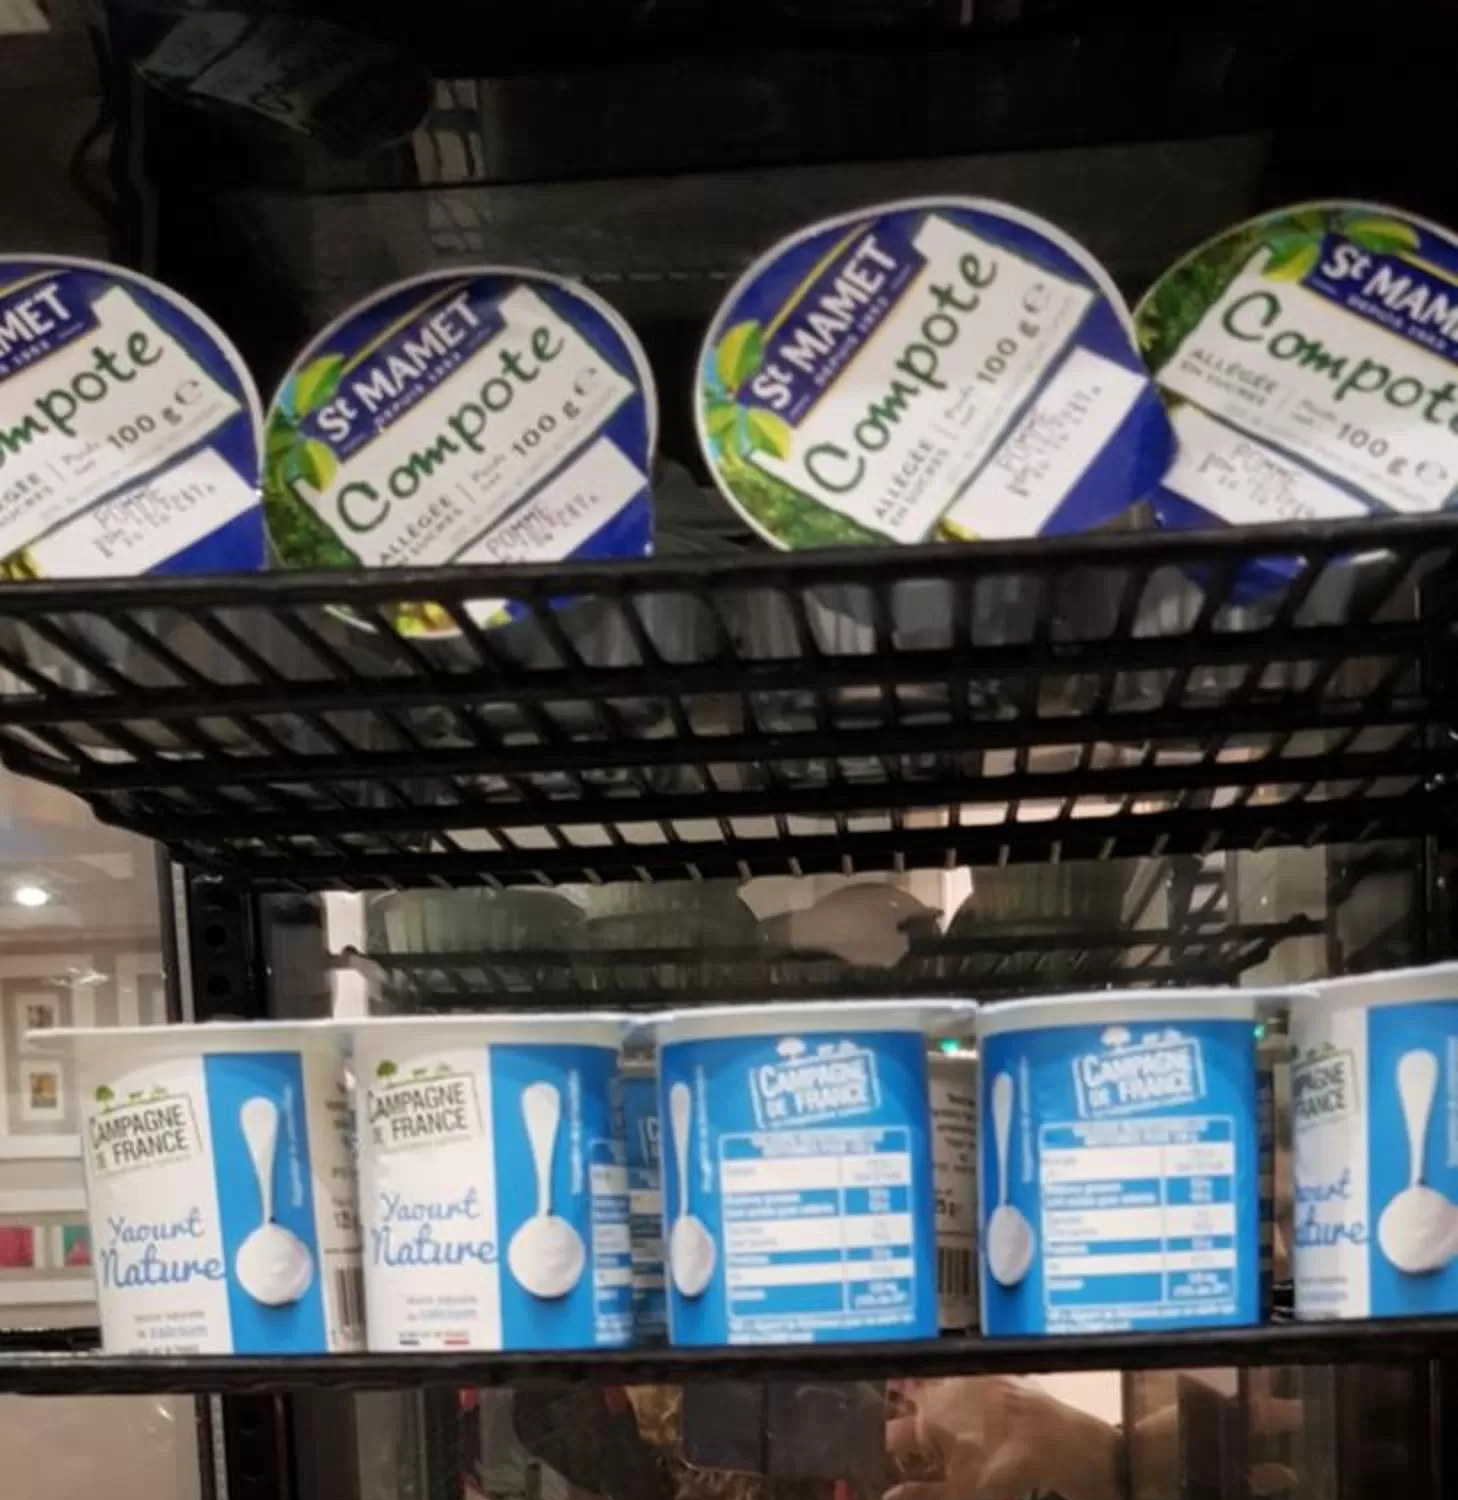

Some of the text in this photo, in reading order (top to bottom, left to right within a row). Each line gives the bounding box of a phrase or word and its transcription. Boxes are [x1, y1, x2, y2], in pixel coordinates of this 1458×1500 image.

[780, 234, 898, 374] MAMET
[352, 290, 480, 414] MAMET
[803, 251, 999, 494] Compote
[976, 337, 1019, 385] 100
[0, 331, 164, 468] mpote
[106, 413, 157, 450] 100
[336, 325, 566, 534] Compote
[512, 414, 557, 458] 100
[1337, 422, 1391, 460] 100
[390, 1107, 469, 1142] FRANCE
[111, 1129, 189, 1166] FRANCE
[107, 1207, 206, 1246] Yaourt
[378, 1188, 481, 1222] Yaourt
[369, 1224, 499, 1267] Nature
[100, 1248, 227, 1289] Nature
